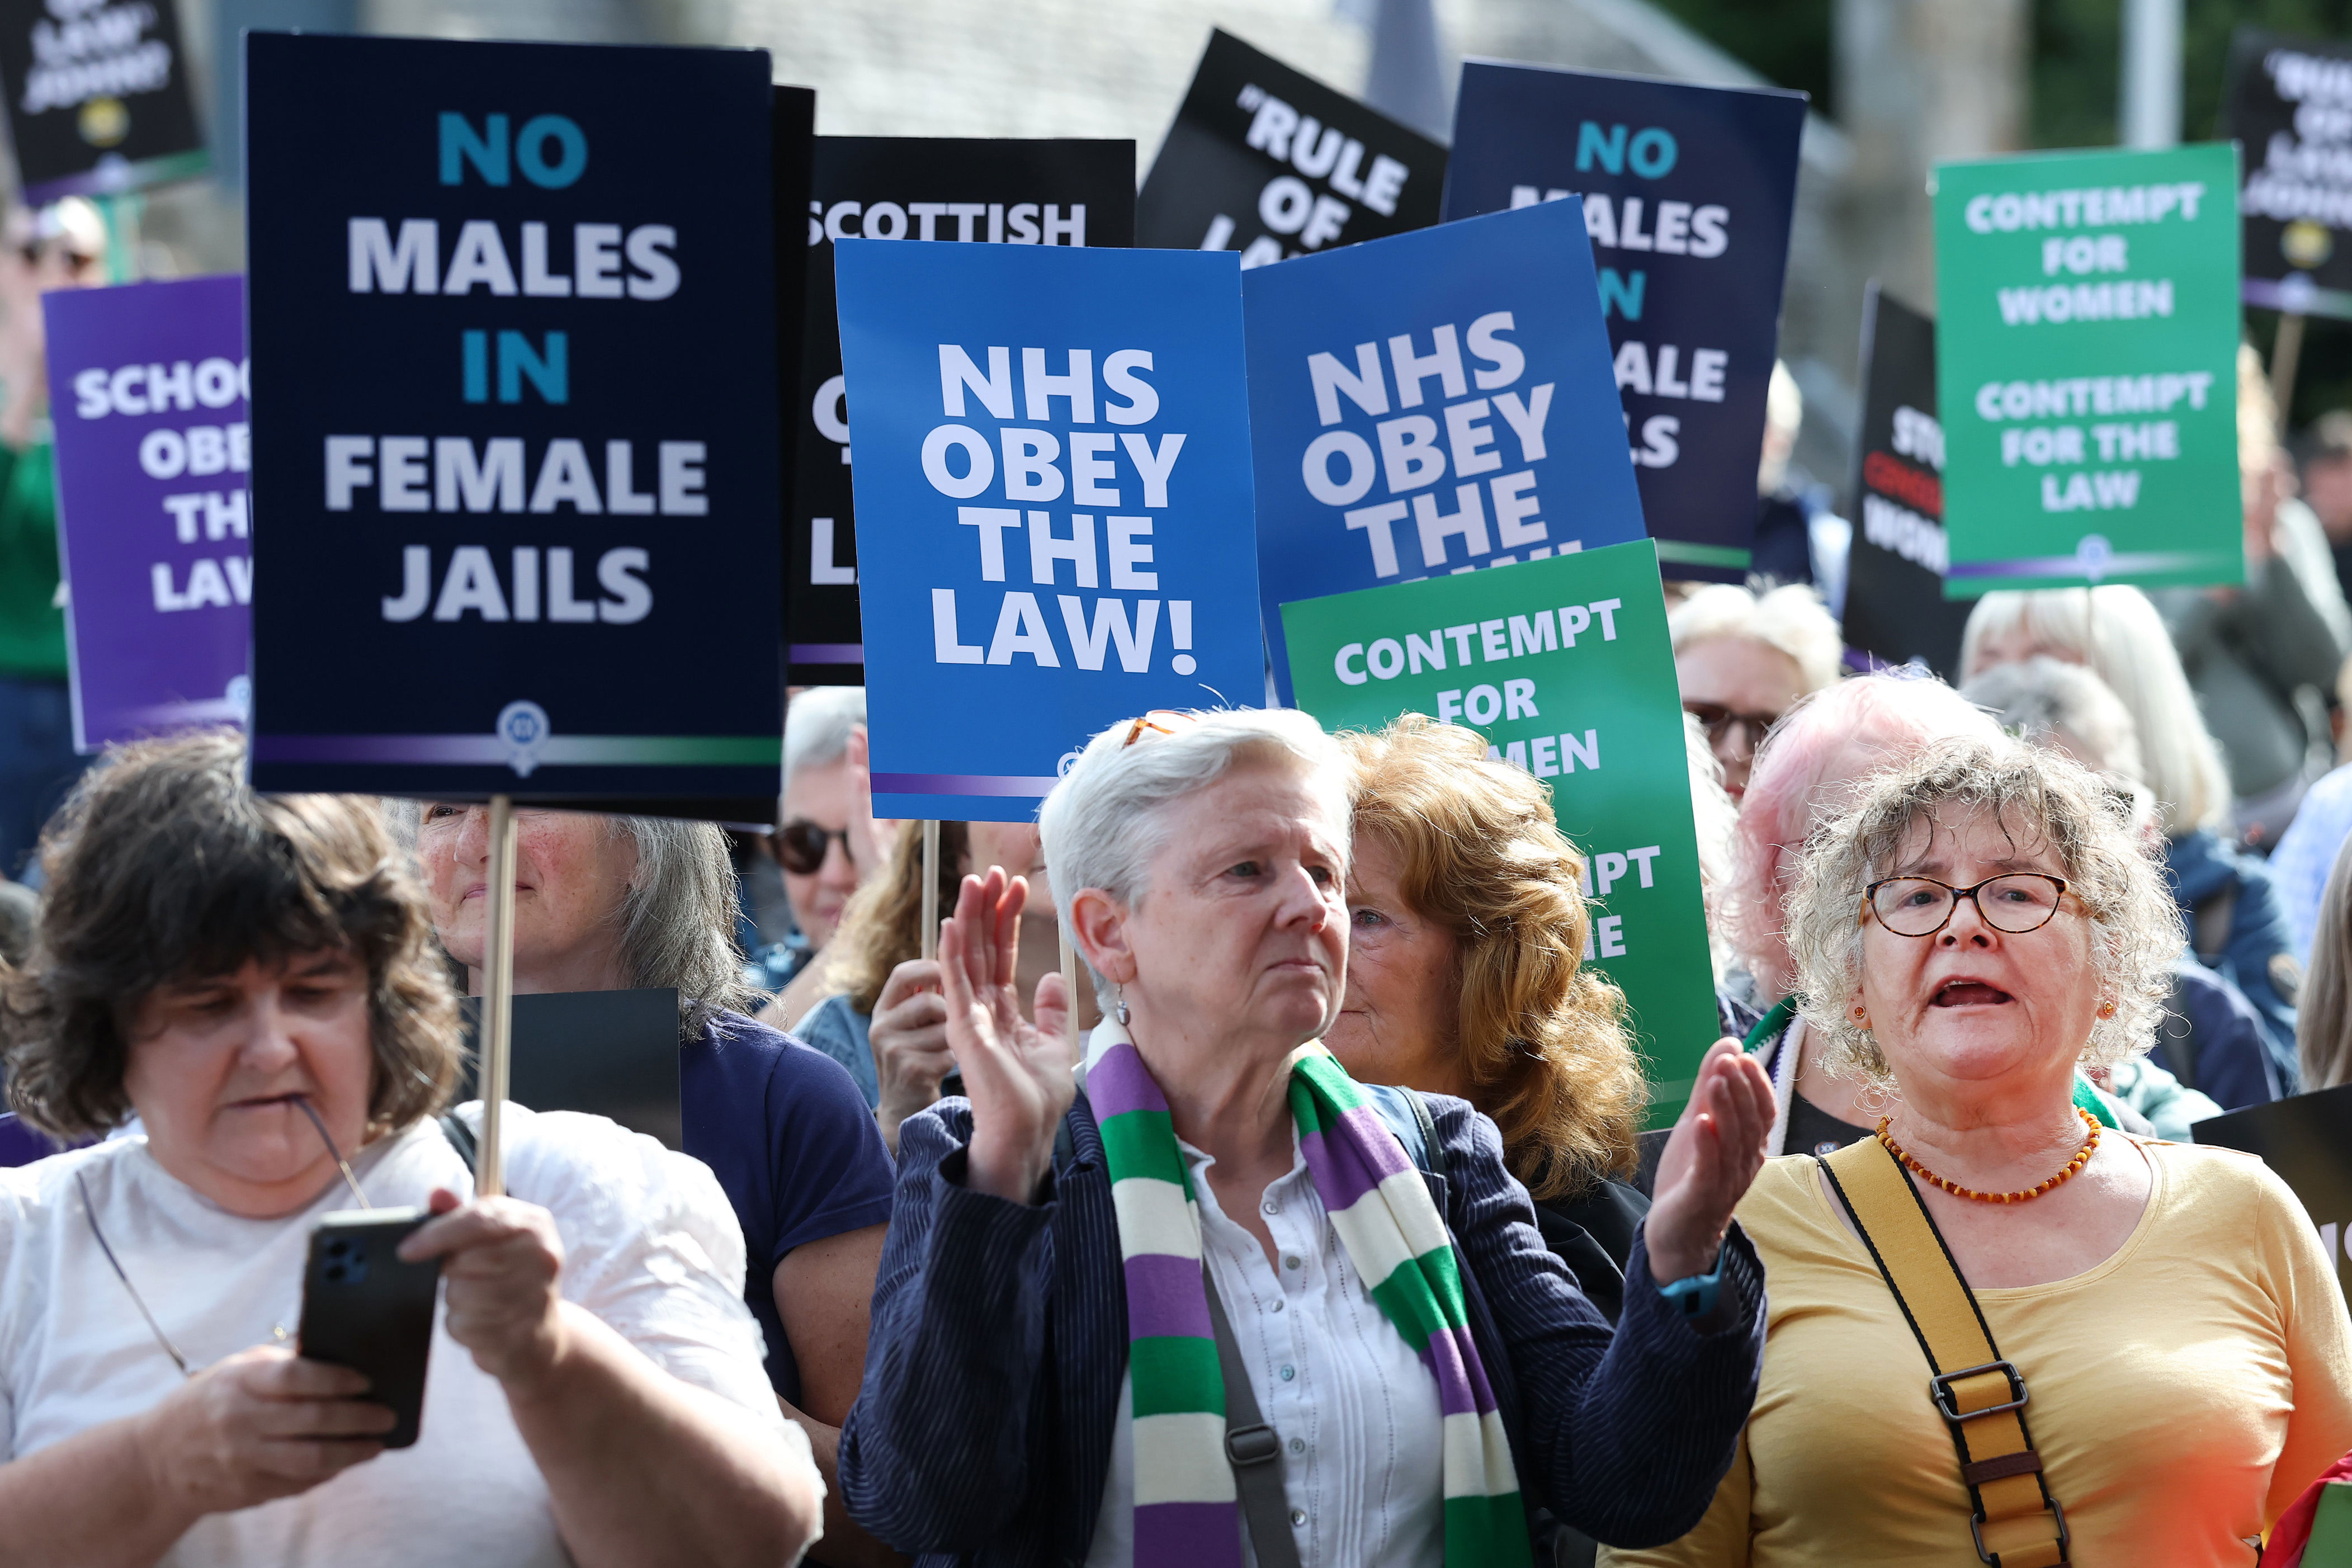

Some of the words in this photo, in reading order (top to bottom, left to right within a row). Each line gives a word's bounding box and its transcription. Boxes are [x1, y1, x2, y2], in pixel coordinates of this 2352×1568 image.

[439, 112, 587, 188] NO
[1236, 83, 1410, 218] "RULE
[1576, 122, 1677, 178] NO
[808, 200, 1088, 247] SCOTTISH
[1258, 175, 1351, 250] OF
[1966, 182, 2204, 233] CONTEMPT
[349, 219, 679, 299] MALES
[2043, 235, 2127, 275] FOR
[1598, 267, 1646, 321] N
[1999, 280, 2173, 324] WOMEN
[463, 330, 568, 403] IN
[937, 344, 1160, 426] NHS
[1307, 311, 1526, 426] NHS
[1614, 341, 1728, 403] ALE
[1976, 372, 2213, 421] CONTEMPT
[140, 423, 249, 478] OBE
[326, 436, 707, 514] FEMALE
[921, 423, 1187, 508] OBEY
[1302, 382, 1555, 506] OBEY
[2002, 427, 2084, 465] FOR
[2092, 421, 2178, 461] THE
[164, 490, 248, 542] TH
[1344, 470, 1548, 578] THE
[2042, 471, 2140, 511] LAW
[383, 546, 651, 622] JAILS
[958, 507, 1159, 591] THE
[932, 588, 1197, 676] LAW!
[1335, 598, 1621, 686] CONTEMPT
[1437, 678, 1539, 725] FOR
[1486, 729, 1600, 778] MEN
